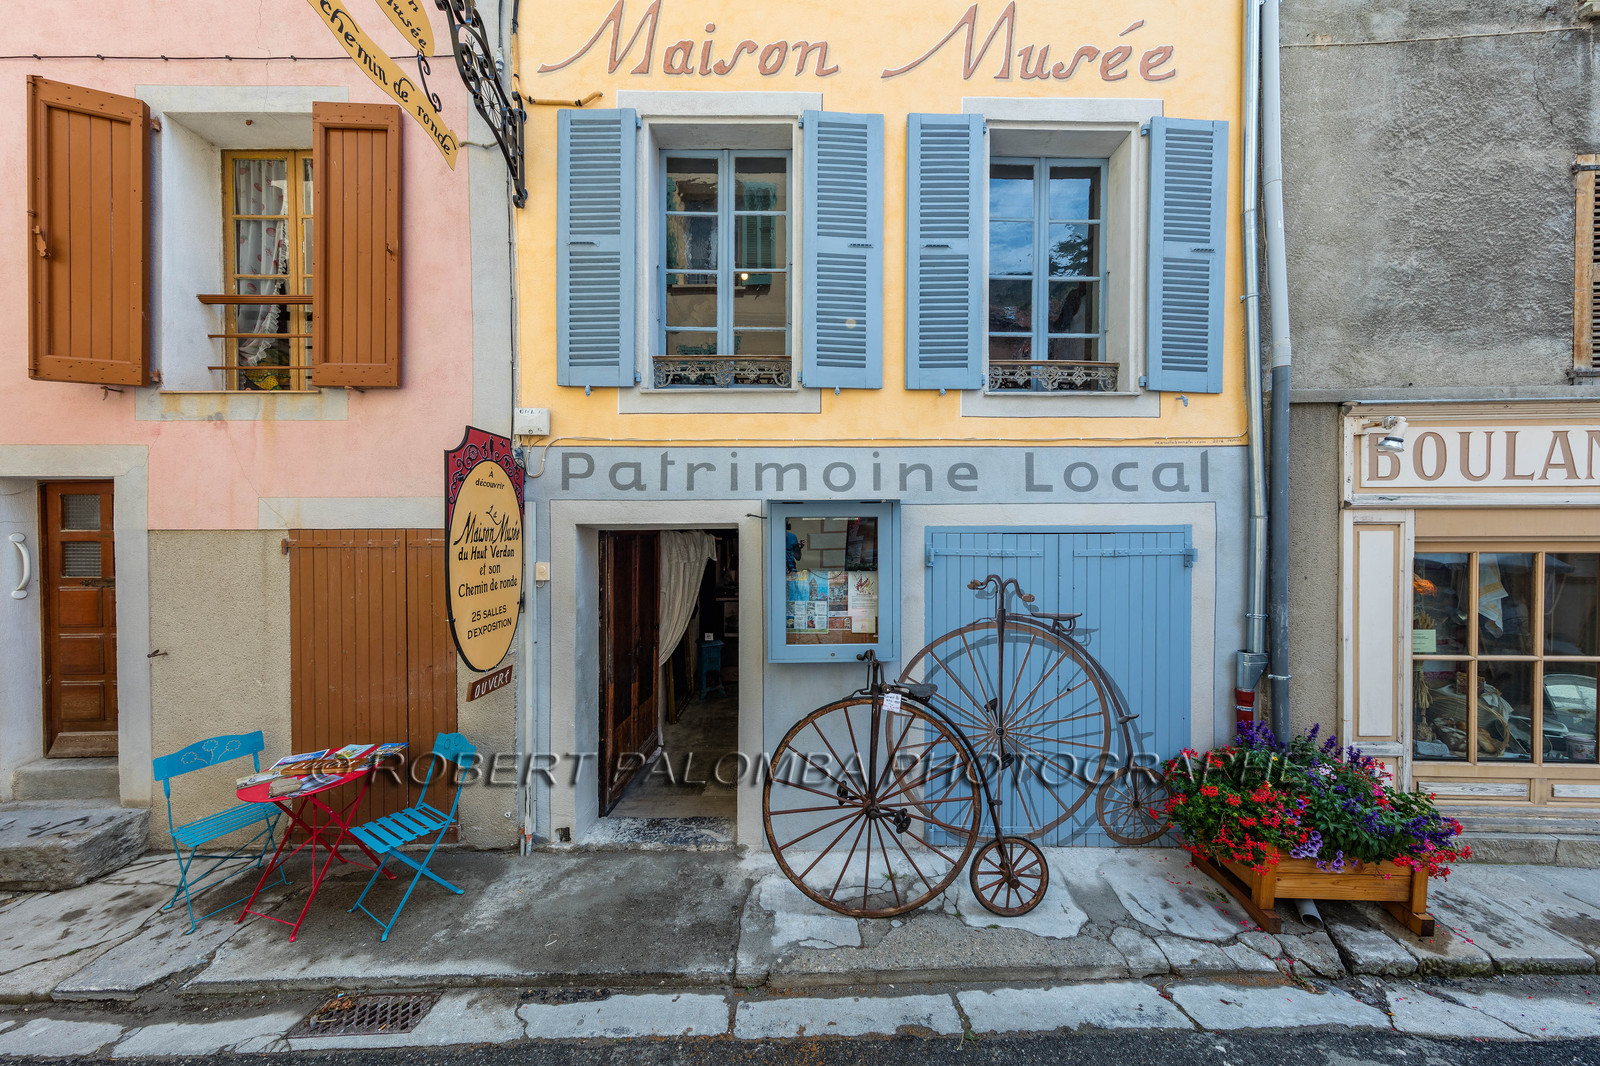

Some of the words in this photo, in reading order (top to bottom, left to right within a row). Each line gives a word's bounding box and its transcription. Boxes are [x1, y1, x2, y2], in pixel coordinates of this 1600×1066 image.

[386, 0, 427, 49] usée
[536, 0, 839, 78] Maison
[880, 2, 1177, 82] Musée
[393, 77, 416, 103] de
[417, 105, 457, 156] ronde
[475, 478, 505, 490] découvrir
[561, 450, 979, 493] Patrimoine
[1025, 449, 1209, 493] Local
[453, 511, 495, 546] Maison
[492, 512, 521, 545] Musée
[458, 547, 469, 561] du
[470, 545, 488, 561] Haut
[490, 545, 515, 559] Verdon
[479, 563, 486, 576] et
[488, 564, 501, 575] son
[458, 581, 489, 598] Chemin
[489, 579, 499, 592] de
[499, 575, 518, 589] ronde
[471, 610, 482, 623] 25
[482, 604, 507, 620] SALLES
